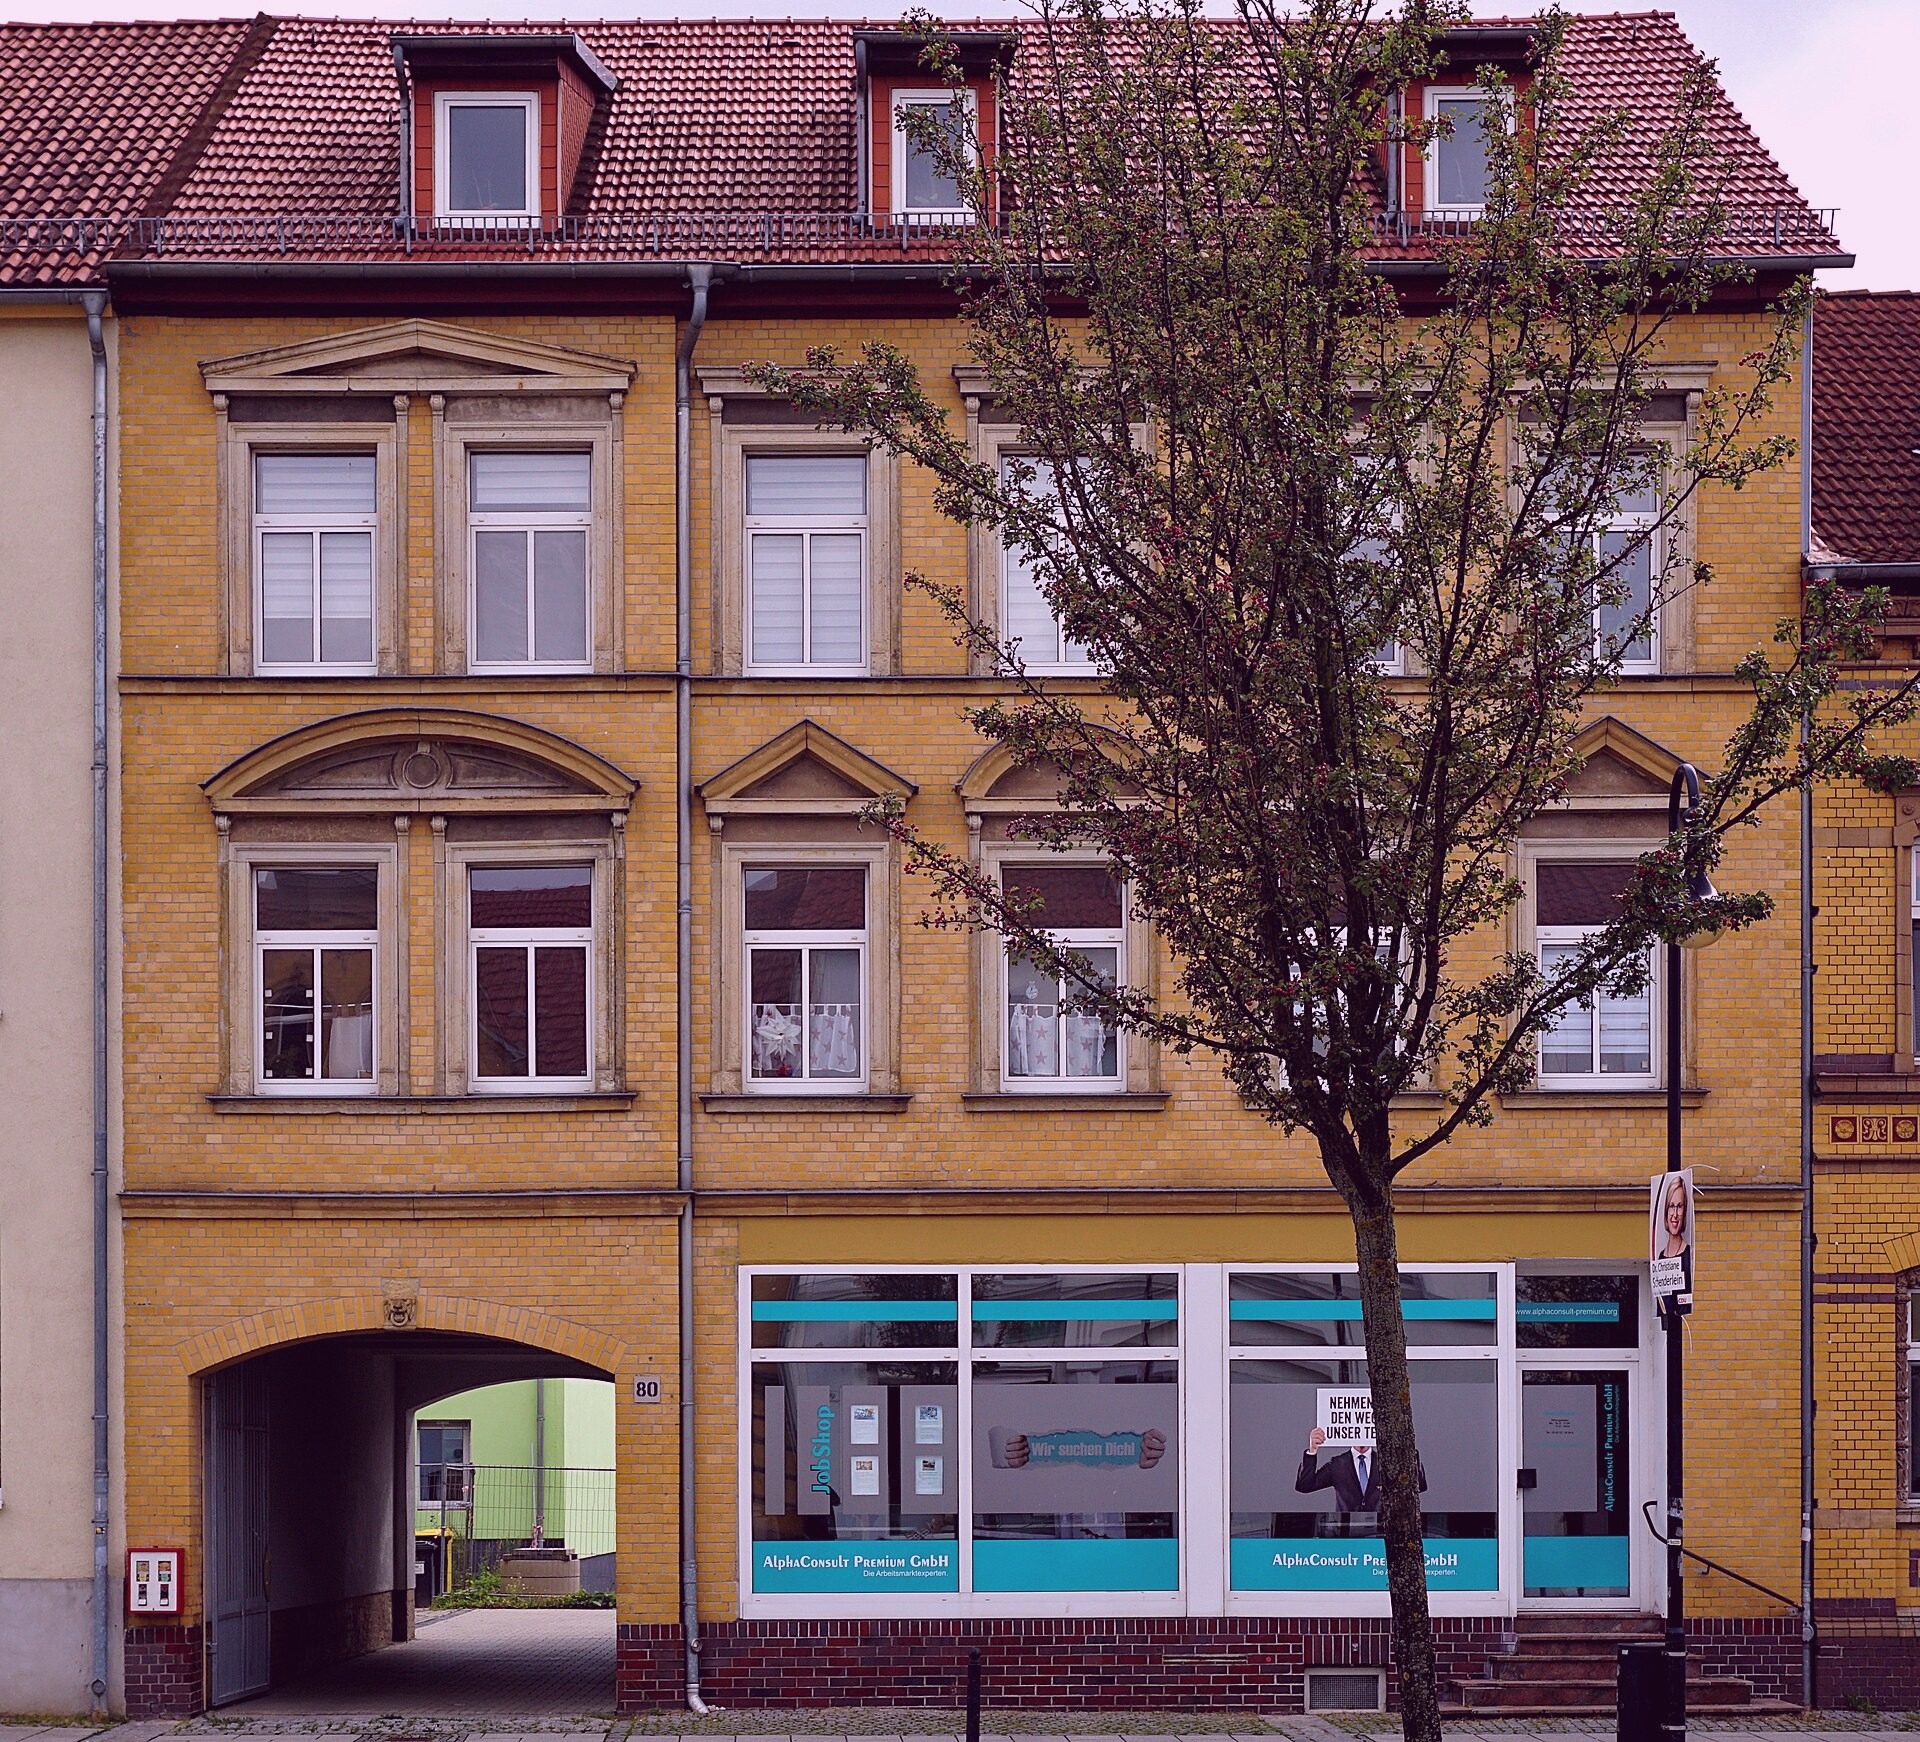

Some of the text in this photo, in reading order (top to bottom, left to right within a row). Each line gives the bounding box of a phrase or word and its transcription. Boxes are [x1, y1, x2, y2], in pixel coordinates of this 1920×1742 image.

[1658, 1261, 1680, 1272] Christiane
[1652, 1274, 1683, 1288] Schenderlein
[636, 1381, 658, 1397] 80
[1331, 1411, 1351, 1424] DEN
[1326, 1426, 1377, 1439] UNSER TE
[810, 1405, 835, 1495] JobShop
[1031, 1442, 1055, 1456] Wir
[1058, 1442, 1102, 1456] suchen
[1604, 1384, 1615, 1512] AlphaConsult Premium GmbH
[763, 1555, 949, 1570] AlphaConsult Premium GmbH
[1272, 1553, 1358, 1568] AlphaConsult
[876, 1570, 949, 1578] Arbeitsmarktexperten.
